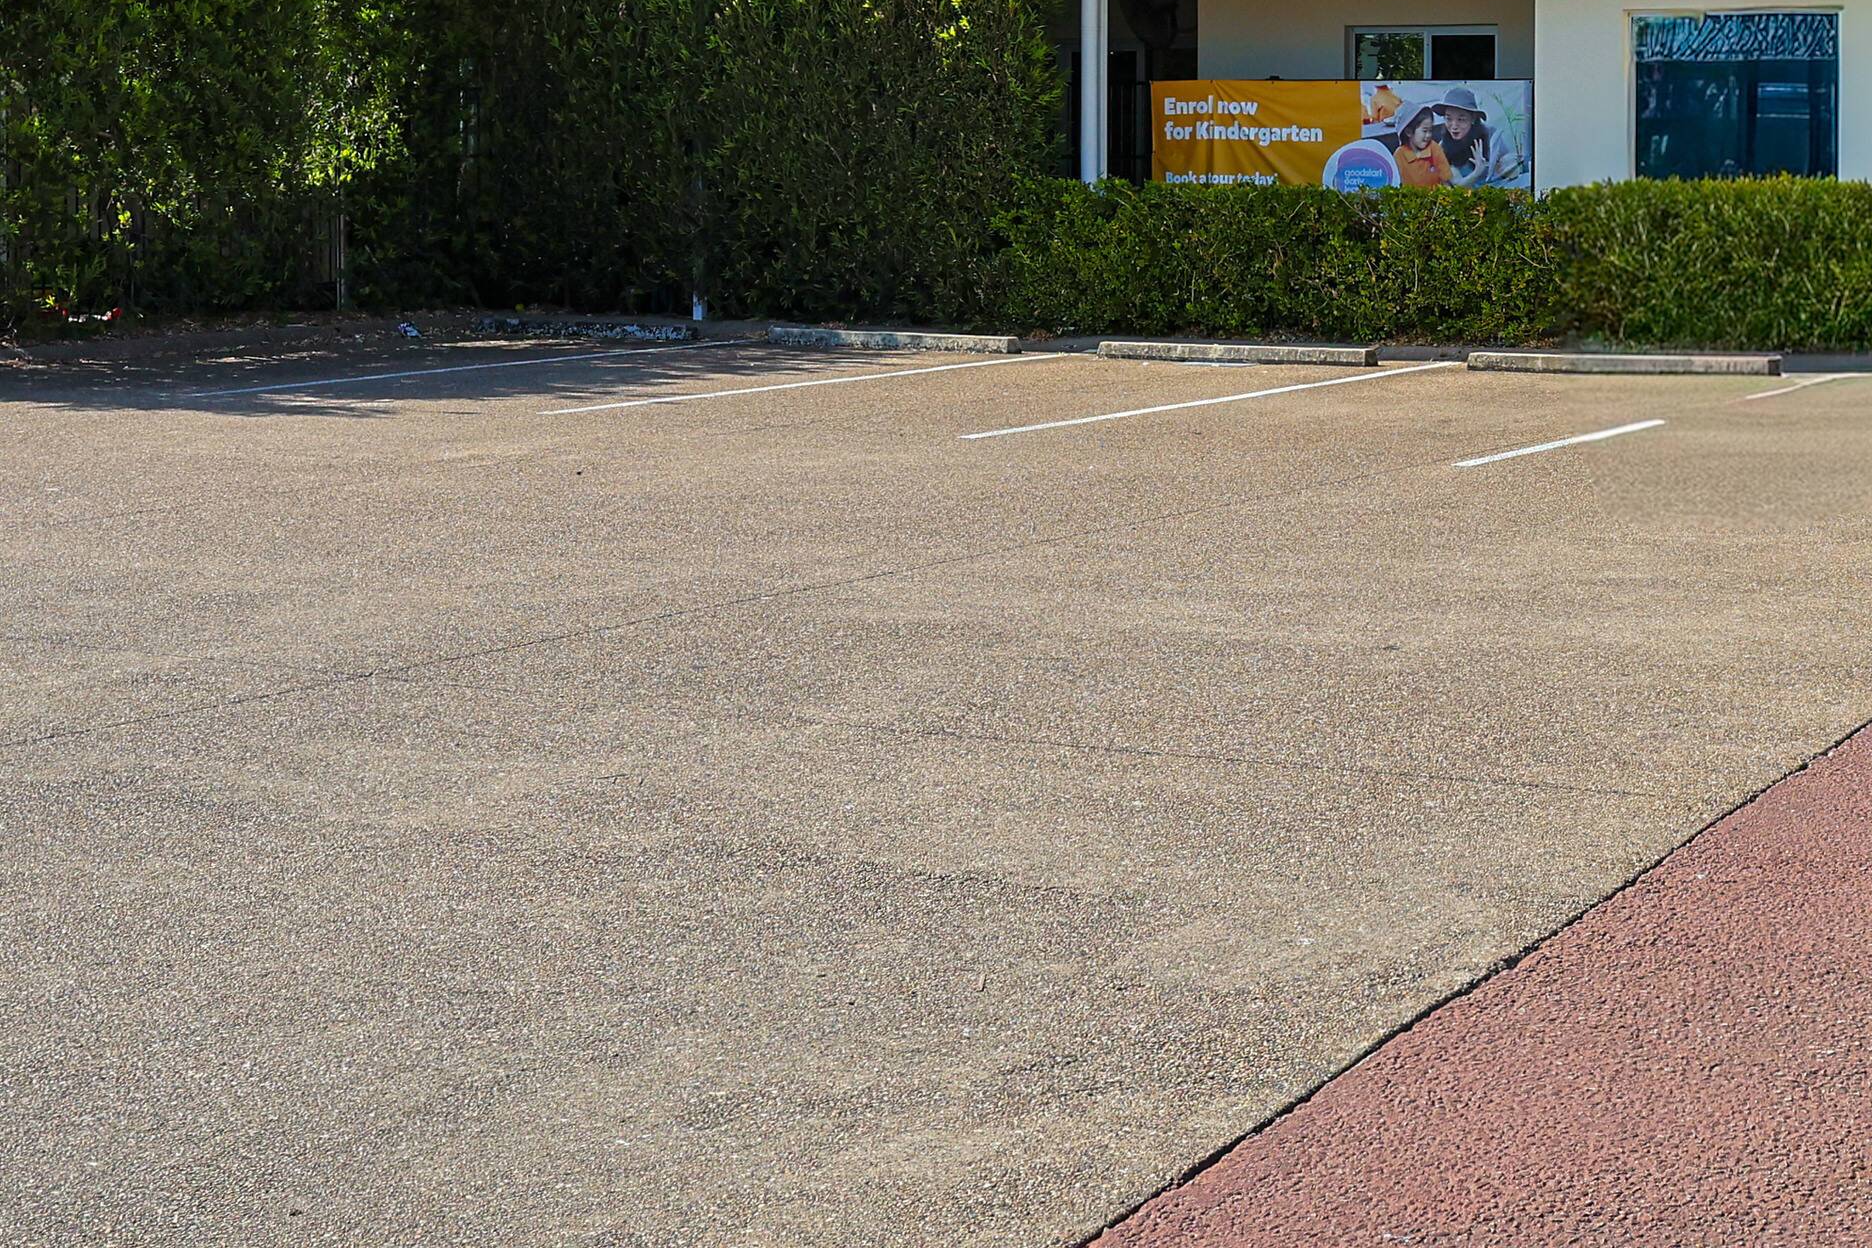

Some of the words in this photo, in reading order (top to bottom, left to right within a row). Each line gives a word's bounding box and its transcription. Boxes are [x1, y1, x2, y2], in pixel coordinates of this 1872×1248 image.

[1164, 95, 1214, 116] Enrol
[1217, 100, 1258, 116] now
[1164, 123, 1194, 141] for
[1196, 120, 1323, 147] Kindergarten
[1344, 168, 1383, 177] goodstart
